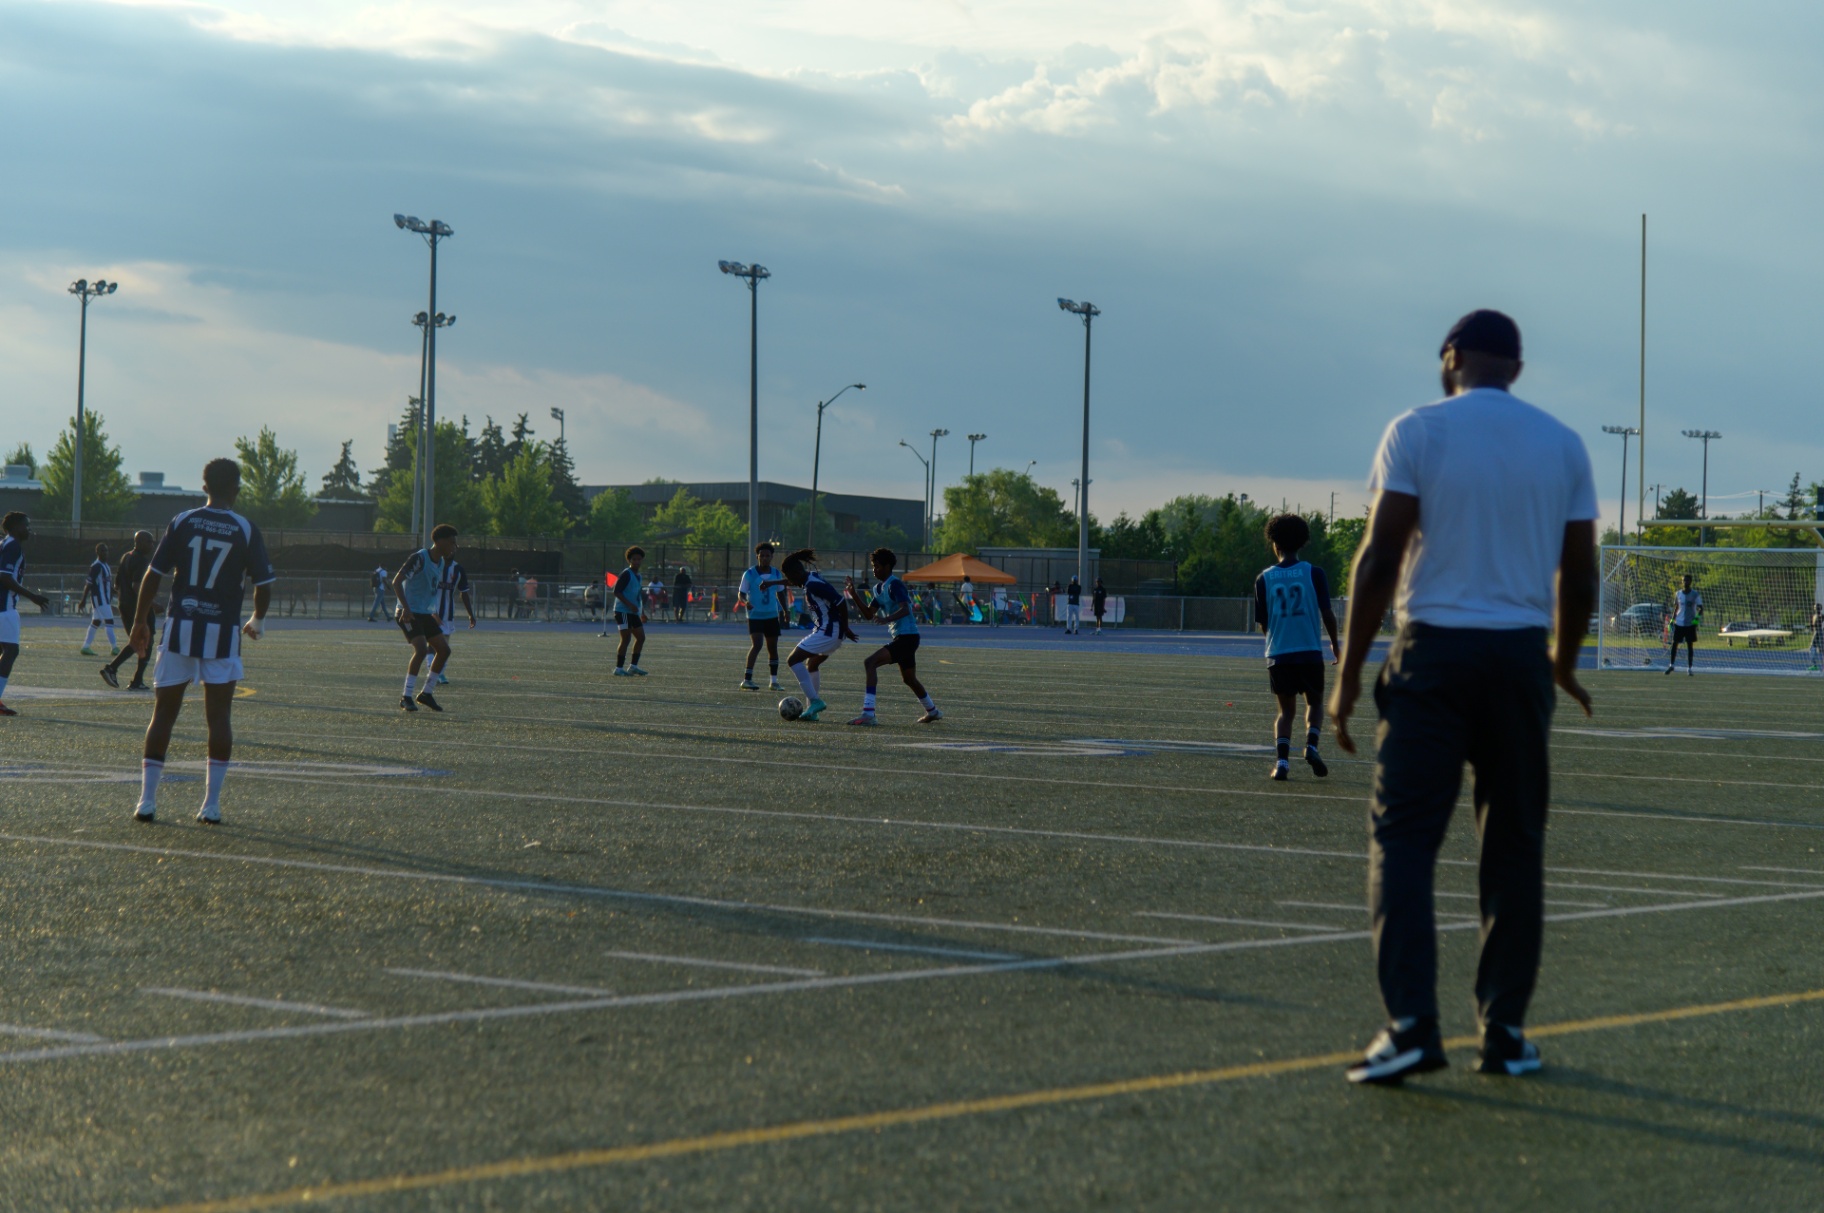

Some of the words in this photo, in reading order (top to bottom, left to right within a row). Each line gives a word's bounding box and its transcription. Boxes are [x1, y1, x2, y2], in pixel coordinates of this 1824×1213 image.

[188, 535, 233, 589] 17
[1269, 569, 1303, 580] ERITREA
[1274, 584, 1306, 618] 12
